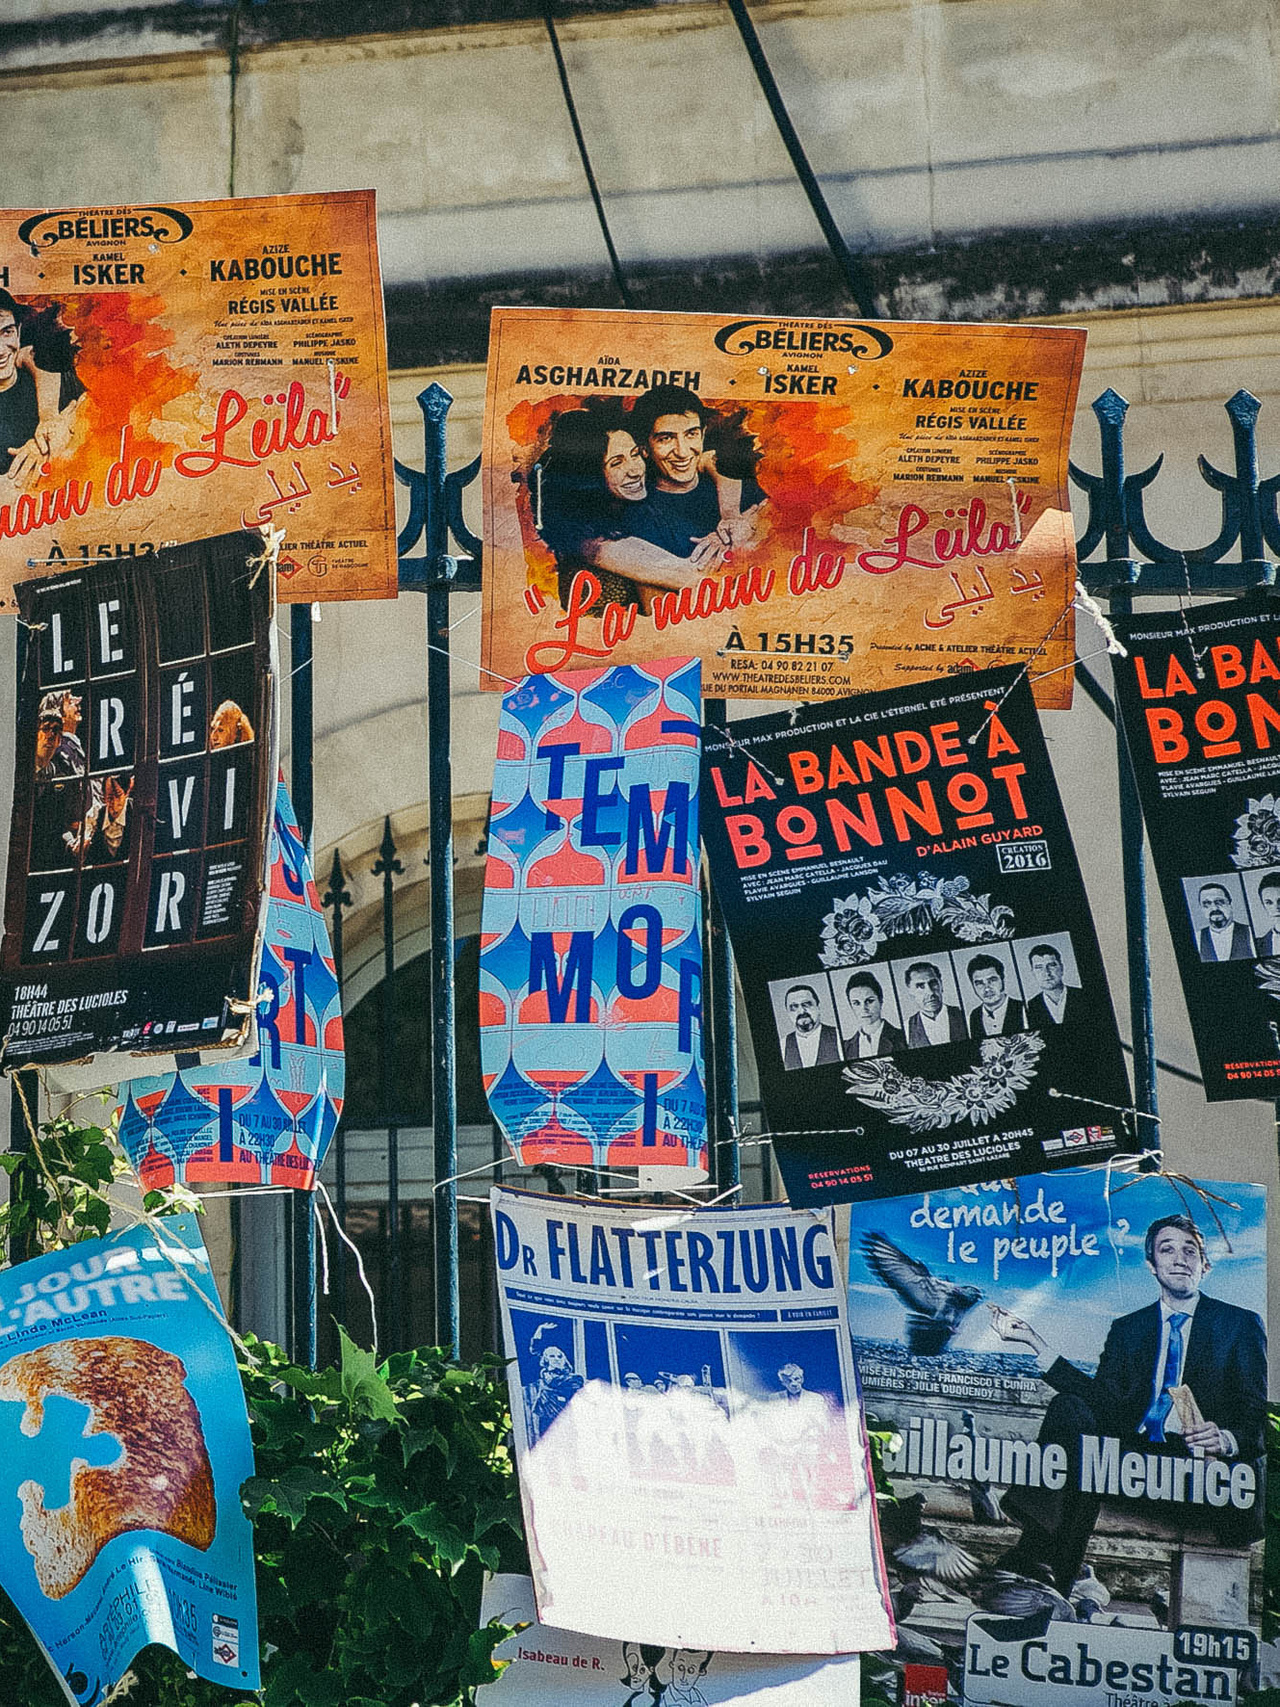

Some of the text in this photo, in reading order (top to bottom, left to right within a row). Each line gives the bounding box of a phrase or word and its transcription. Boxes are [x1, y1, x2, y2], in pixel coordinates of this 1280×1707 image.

[58, 215, 154, 240] BÉLIERS
[74, 264, 145, 285] ISKER
[210, 253, 342, 281] KABOUCHE
[755, 327, 854, 354] BÉLIERS
[516, 365, 700, 391] ASGHARZADEH
[764, 373, 838, 396] ISKER
[903, 379, 1039, 400] KABOUCHE
[106, 424, 165, 505] de
[652, 549, 776, 630] main
[788, 527, 846, 599] de
[712, 672, 851, 685] WWW.THEATREDESBELIERS.COM
[1133, 653, 1197, 700] LA
[774, 687, 1006, 740] PRODUCTION ET LA CIE L'ÉTERNEL ÉTÉ PRÉSENTENT
[710, 699, 1020, 809] LA BANDE À
[724, 762, 1028, 870] BONNOT
[916, 824, 1043, 859] D'ALAIN GUYARD
[1004, 852, 1047, 870] 2016
[14, 983, 48, 1001] 18H44
[57, 998, 78, 1014] DES
[78, 989, 129, 1011] LUCIOLES
[889, 1150, 904, 1161] DU
[906, 1148, 919, 1159] 07
[921, 1145, 936, 1156] AU
[937, 1142, 951, 1154] 30
[952, 1136, 991, 1151] JUILLET
[1002, 1127, 1035, 1142] 20H45
[951, 1149, 970, 1161] DES
[971, 1141, 1021, 1158] LUCIOLES
[909, 1198, 1067, 1230] demande
[547, 1218, 834, 1295] FLATTERZUNG
[947, 1218, 1130, 1280] le peuple ?
[14, 1246, 144, 1305] JOUR
[6, 1309, 108, 1342] Linda McLean
[938, 1374, 993, 1387] FRANCISCO
[1003, 1379, 1037, 1391] CUNHA
[883, 1416, 1256, 1508] uillaume Meurice
[518, 1646, 606, 1671] Isabeau de R.
[1180, 1633, 1251, 1661] 19h15
[968, 1639, 1233, 1701] Le Cabestan
